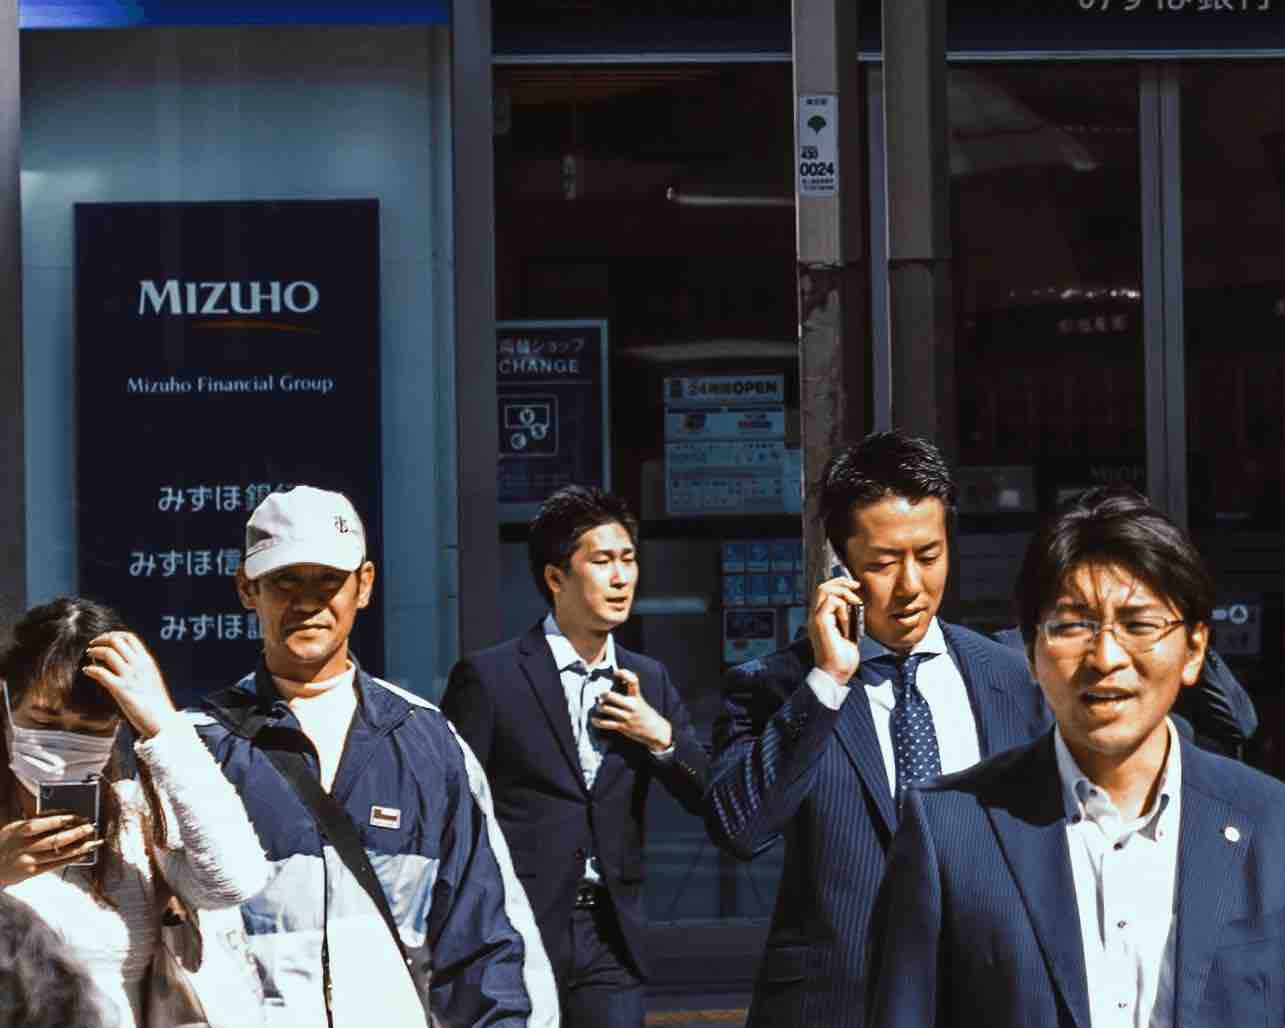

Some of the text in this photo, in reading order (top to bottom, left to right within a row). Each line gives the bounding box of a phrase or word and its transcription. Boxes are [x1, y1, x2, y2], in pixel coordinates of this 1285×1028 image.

[800, 162, 834, 177] 0024
[138, 279, 320, 316] MIZUHO
[127, 373, 334, 395] Mizuho Financial Group
